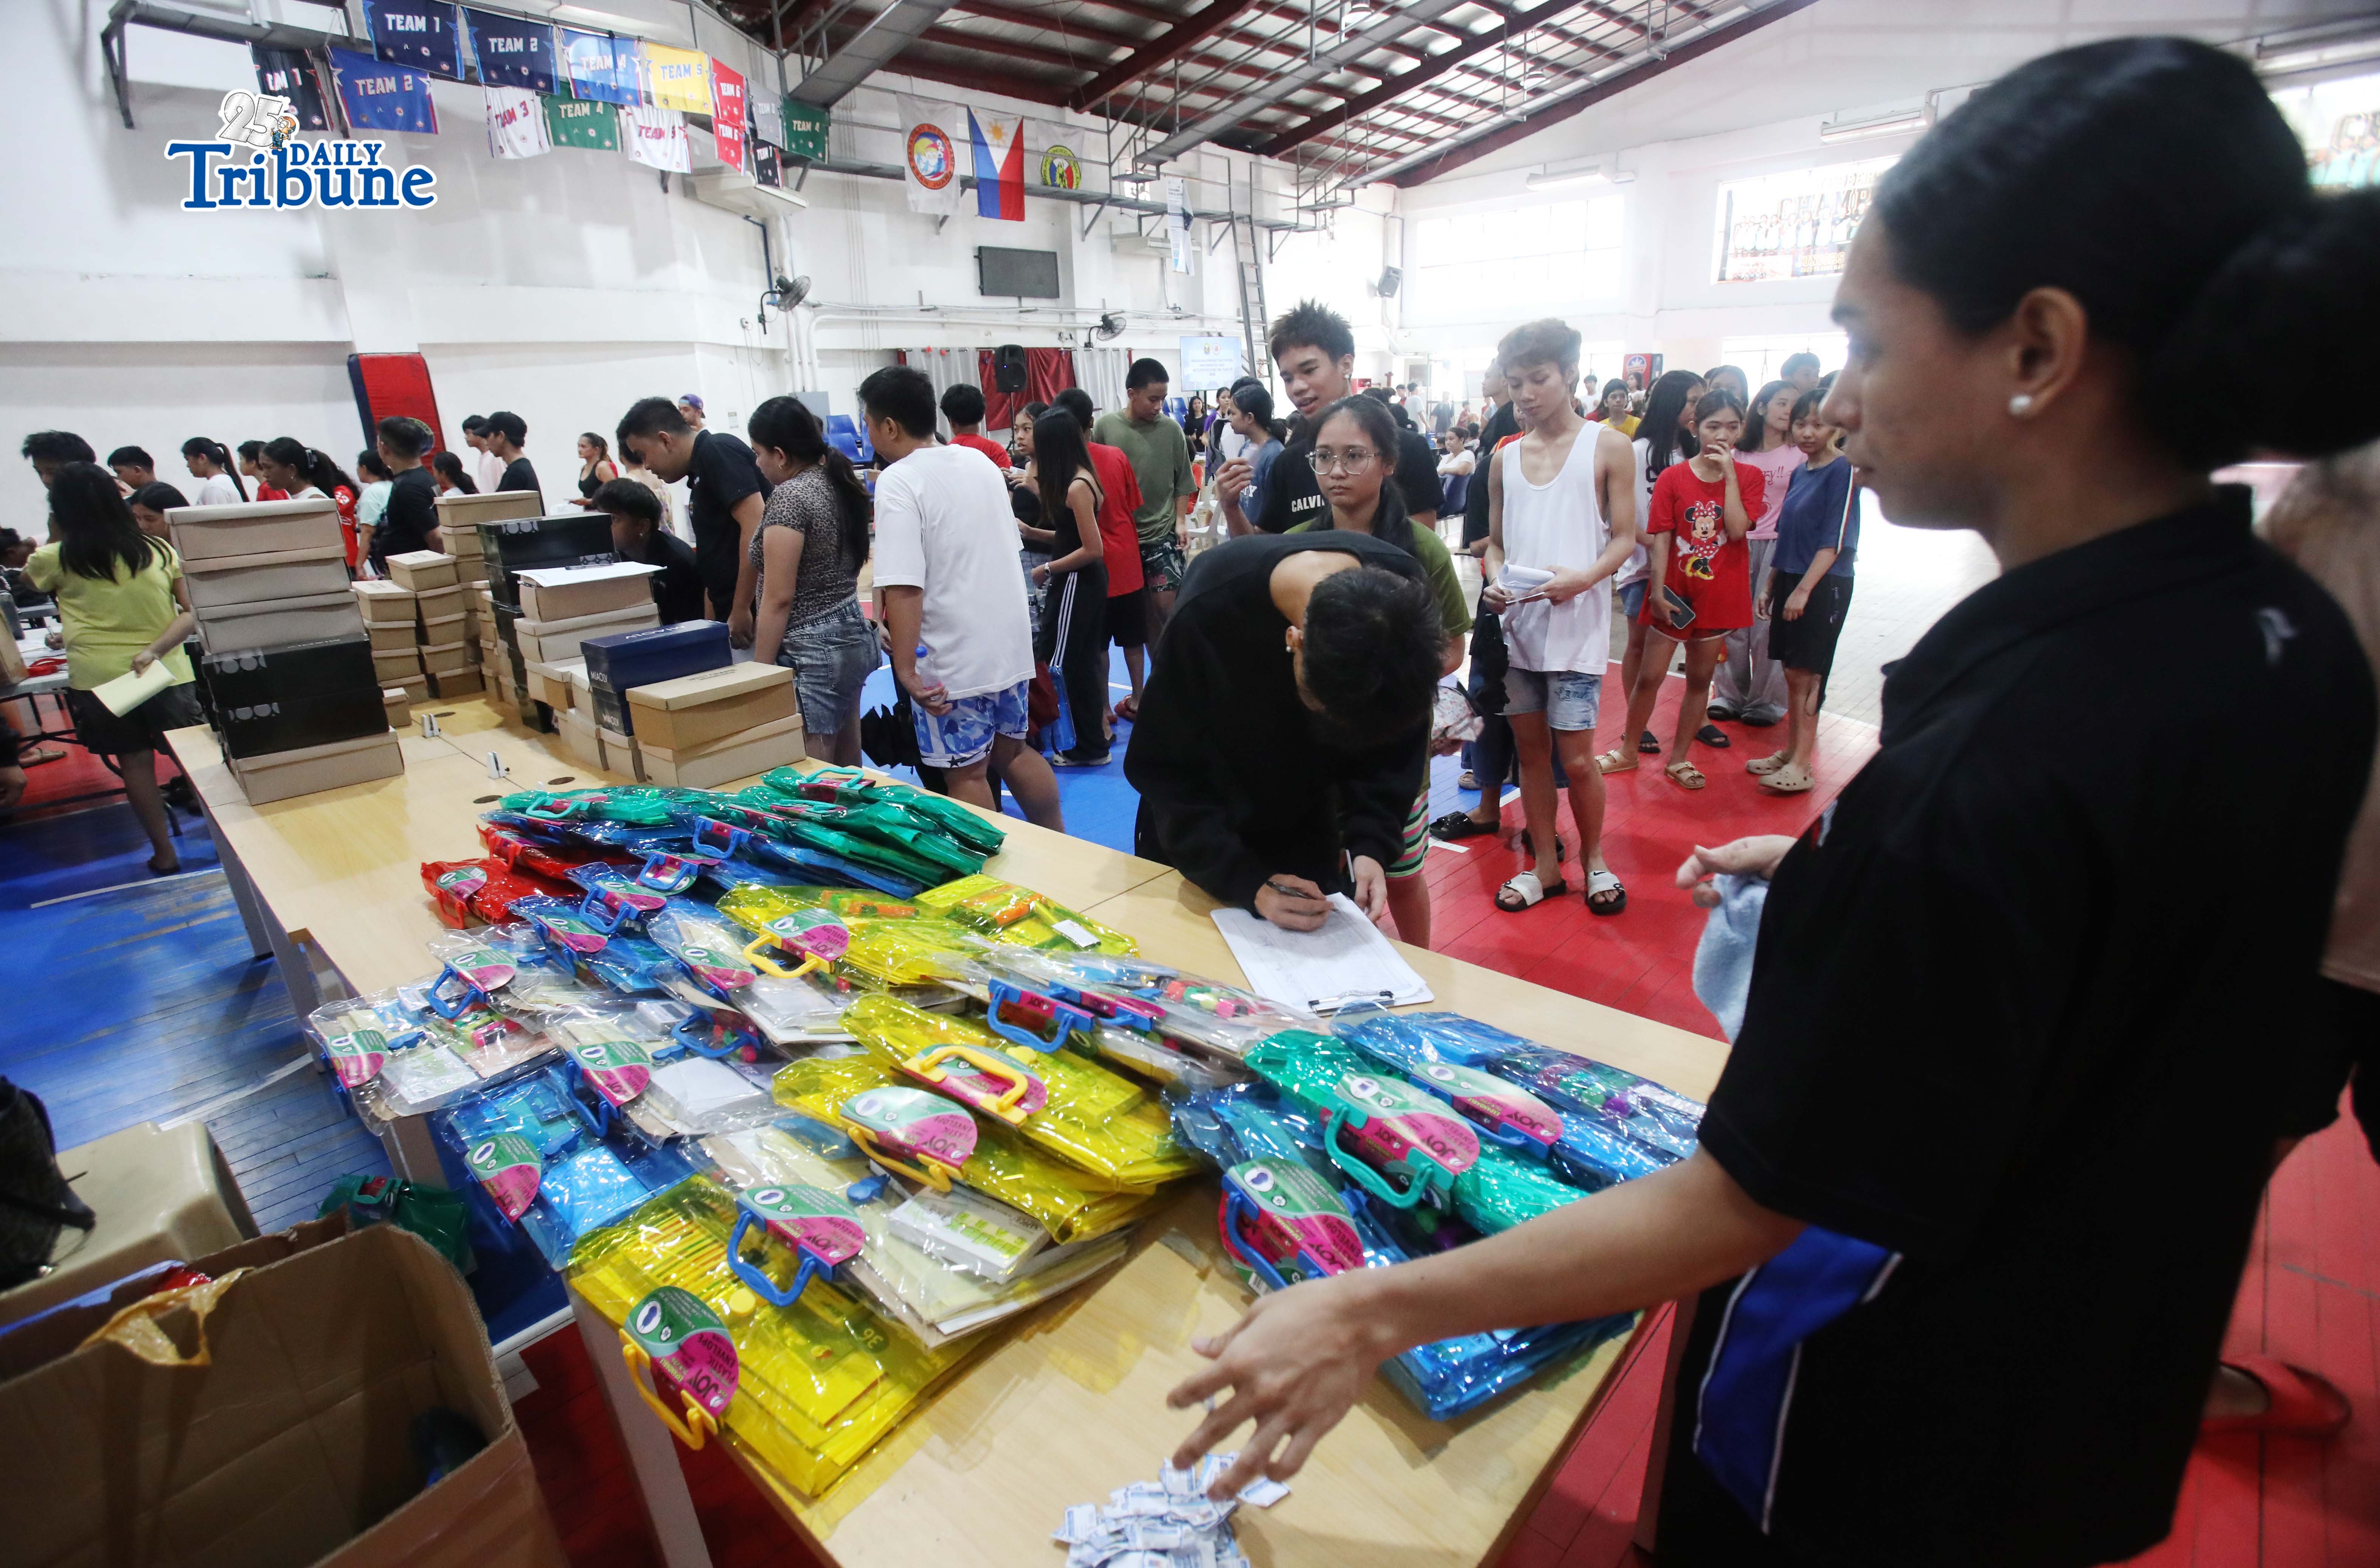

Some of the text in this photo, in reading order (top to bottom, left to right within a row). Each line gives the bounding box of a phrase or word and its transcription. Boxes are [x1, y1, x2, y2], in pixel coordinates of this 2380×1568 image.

[385, 13, 440, 33] TEAM 1
[488, 37, 537, 53] TEAM 2
[581, 54, 626, 71] TEAM 4
[291, 68, 303, 87] 1
[660, 64, 702, 80] TEAM 5
[355, 75, 413, 96] TEAM 2
[720, 82, 741, 98] TEAM 6
[520, 100, 529, 118] 3
[558, 101, 604, 118] TEAM 4
[758, 103, 770, 114] TEAM
[638, 124, 665, 140] TEAM
[718, 123, 733, 139] TEAM
[793, 120, 820, 132] TEAM 4
[756, 146, 772, 161] TEAM 7
[626, 625, 686, 639] MIAOLV
[590, 671, 607, 683] MIAOLV
[821, 925, 846, 941] ENVELOPE
[825, 936, 845, 948] PLASTIC
[810, 941, 833, 955] JOY
[1467, 1096, 1500, 1116] EXPANDABLE
[933, 1115, 973, 1133] ENVELOPE
[1506, 1110, 1545, 1128] JOY
[942, 1127, 972, 1142] PLASTIC
[1374, 1126, 1397, 1146] JOY
[1441, 1130, 1475, 1155] PLASTIC
[921, 1135, 958, 1154] JOY
[1421, 1133, 1458, 1158] JOY
[516, 1165, 536, 1190] ENVELOPE
[497, 1190, 515, 1210] JOY
[825, 1216, 862, 1242] ENVELOPE
[1272, 1214, 1303, 1241] EXPANDABLE
[1321, 1215, 1362, 1257] ENVELOPE
[803, 1231, 839, 1251] JOY
[1307, 1242, 1345, 1267] JOY
[862, 1328, 883, 1349] 36
[698, 1333, 735, 1369] ENVELOPE
[706, 1357, 736, 1383] PLASTIC
[686, 1368, 720, 1401] JOY
